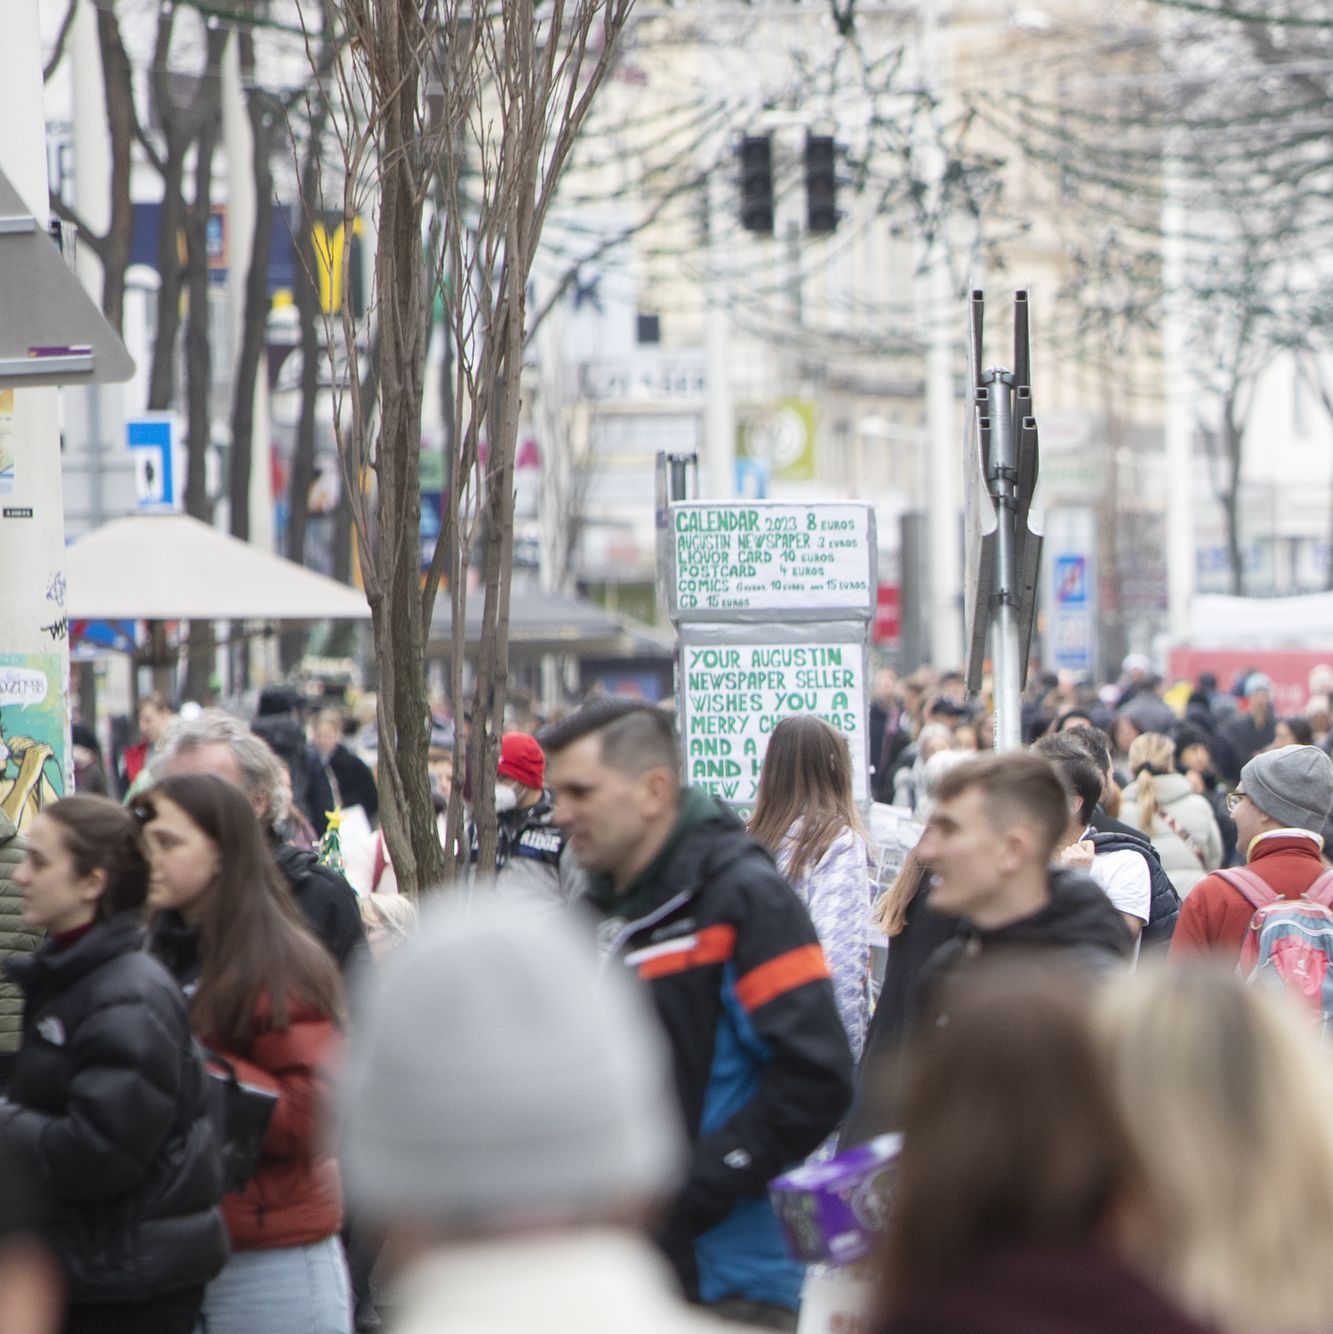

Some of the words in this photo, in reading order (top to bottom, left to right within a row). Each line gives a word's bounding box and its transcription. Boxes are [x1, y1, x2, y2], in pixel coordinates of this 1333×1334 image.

[676, 511, 760, 533] CALENDAR
[765, 516, 797, 532] 2023
[806, 512, 817, 531] 8
[821, 519, 855, 531] EUROS
[677, 534, 730, 550] AUGUSTIN
[738, 532, 811, 549] NEWSPAPER
[678, 552, 729, 565] LIQUOR
[738, 550, 772, 563] CARD
[780, 550, 796, 563] 10
[801, 553, 836, 563] EUROS
[679, 565, 757, 578] POSTCARD
[792, 566, 825, 576] EUROS
[678, 579, 729, 592] COMICS
[680, 594, 698, 609] CD
[706, 595, 719, 607] 15
[689, 649, 741, 669] YOUR
[751, 647, 842, 668] AUGUSTIN
[688, 671, 786, 691] NEWSPAPER
[795, 669, 854, 690] SELLER
[689, 693, 763, 713] WISHES
[774, 692, 818, 711] YOU
[831, 691, 849, 710] A
[690, 715, 750, 735] MERRY
[690, 738, 732, 757] AND
[743, 737, 757, 756] A
[692, 759, 742, 778] AND
